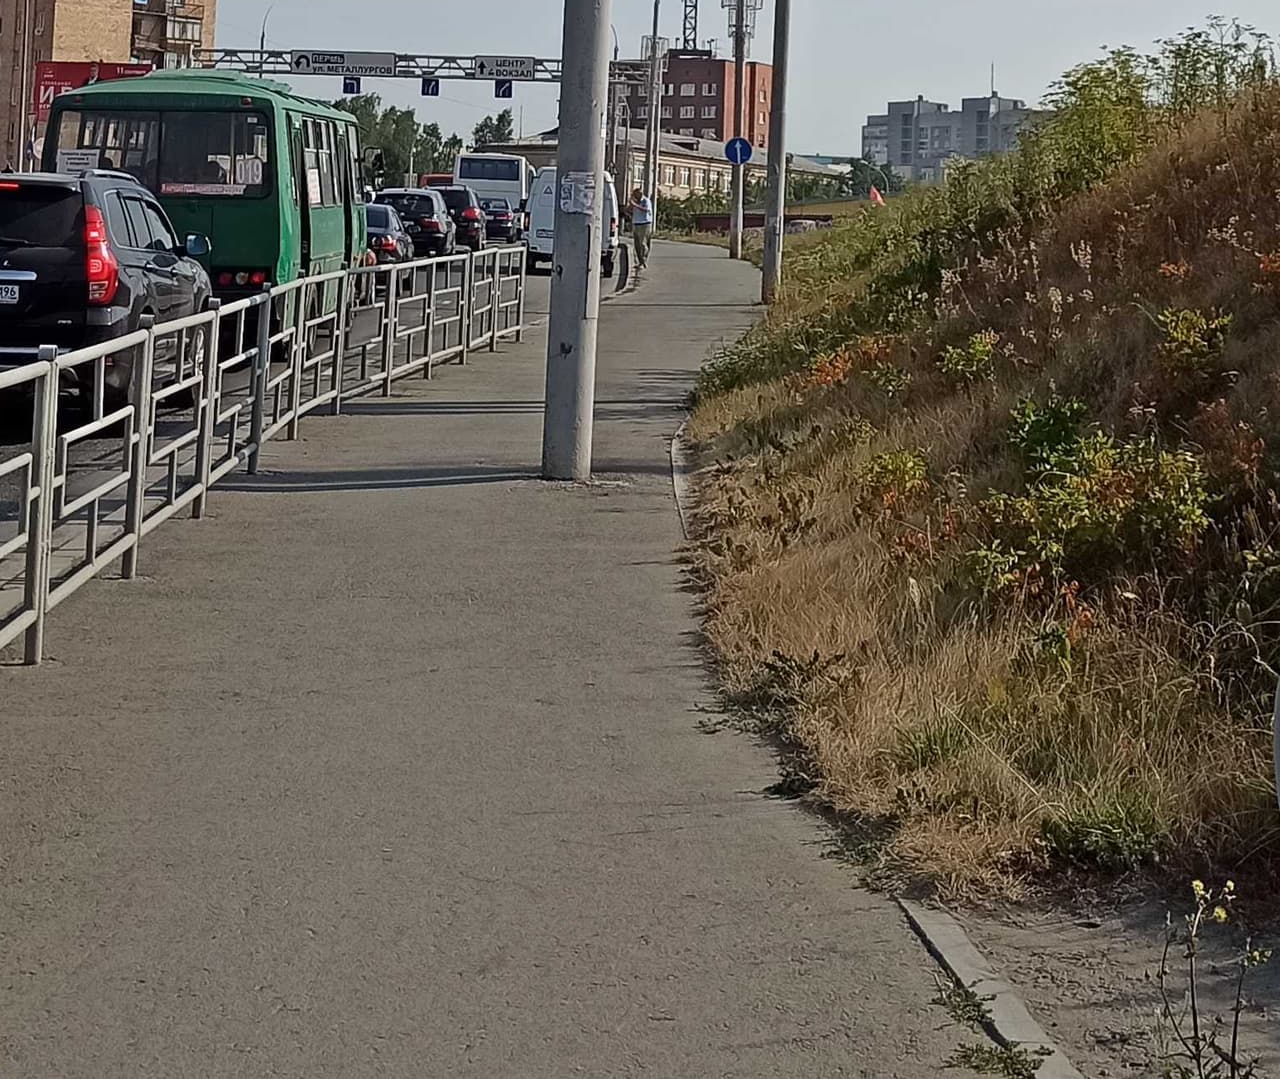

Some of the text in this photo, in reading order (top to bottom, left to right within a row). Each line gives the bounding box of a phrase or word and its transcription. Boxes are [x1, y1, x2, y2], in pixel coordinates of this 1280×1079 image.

[312, 54, 344, 63] ПЕРМЬ
[495, 59, 526, 68] ЦЕНТР
[327, 65, 393, 74] МЕТАЛЛУРГОВ
[495, 69, 532, 78] ВОКЗАЛ
[236, 160, 262, 184] 019
